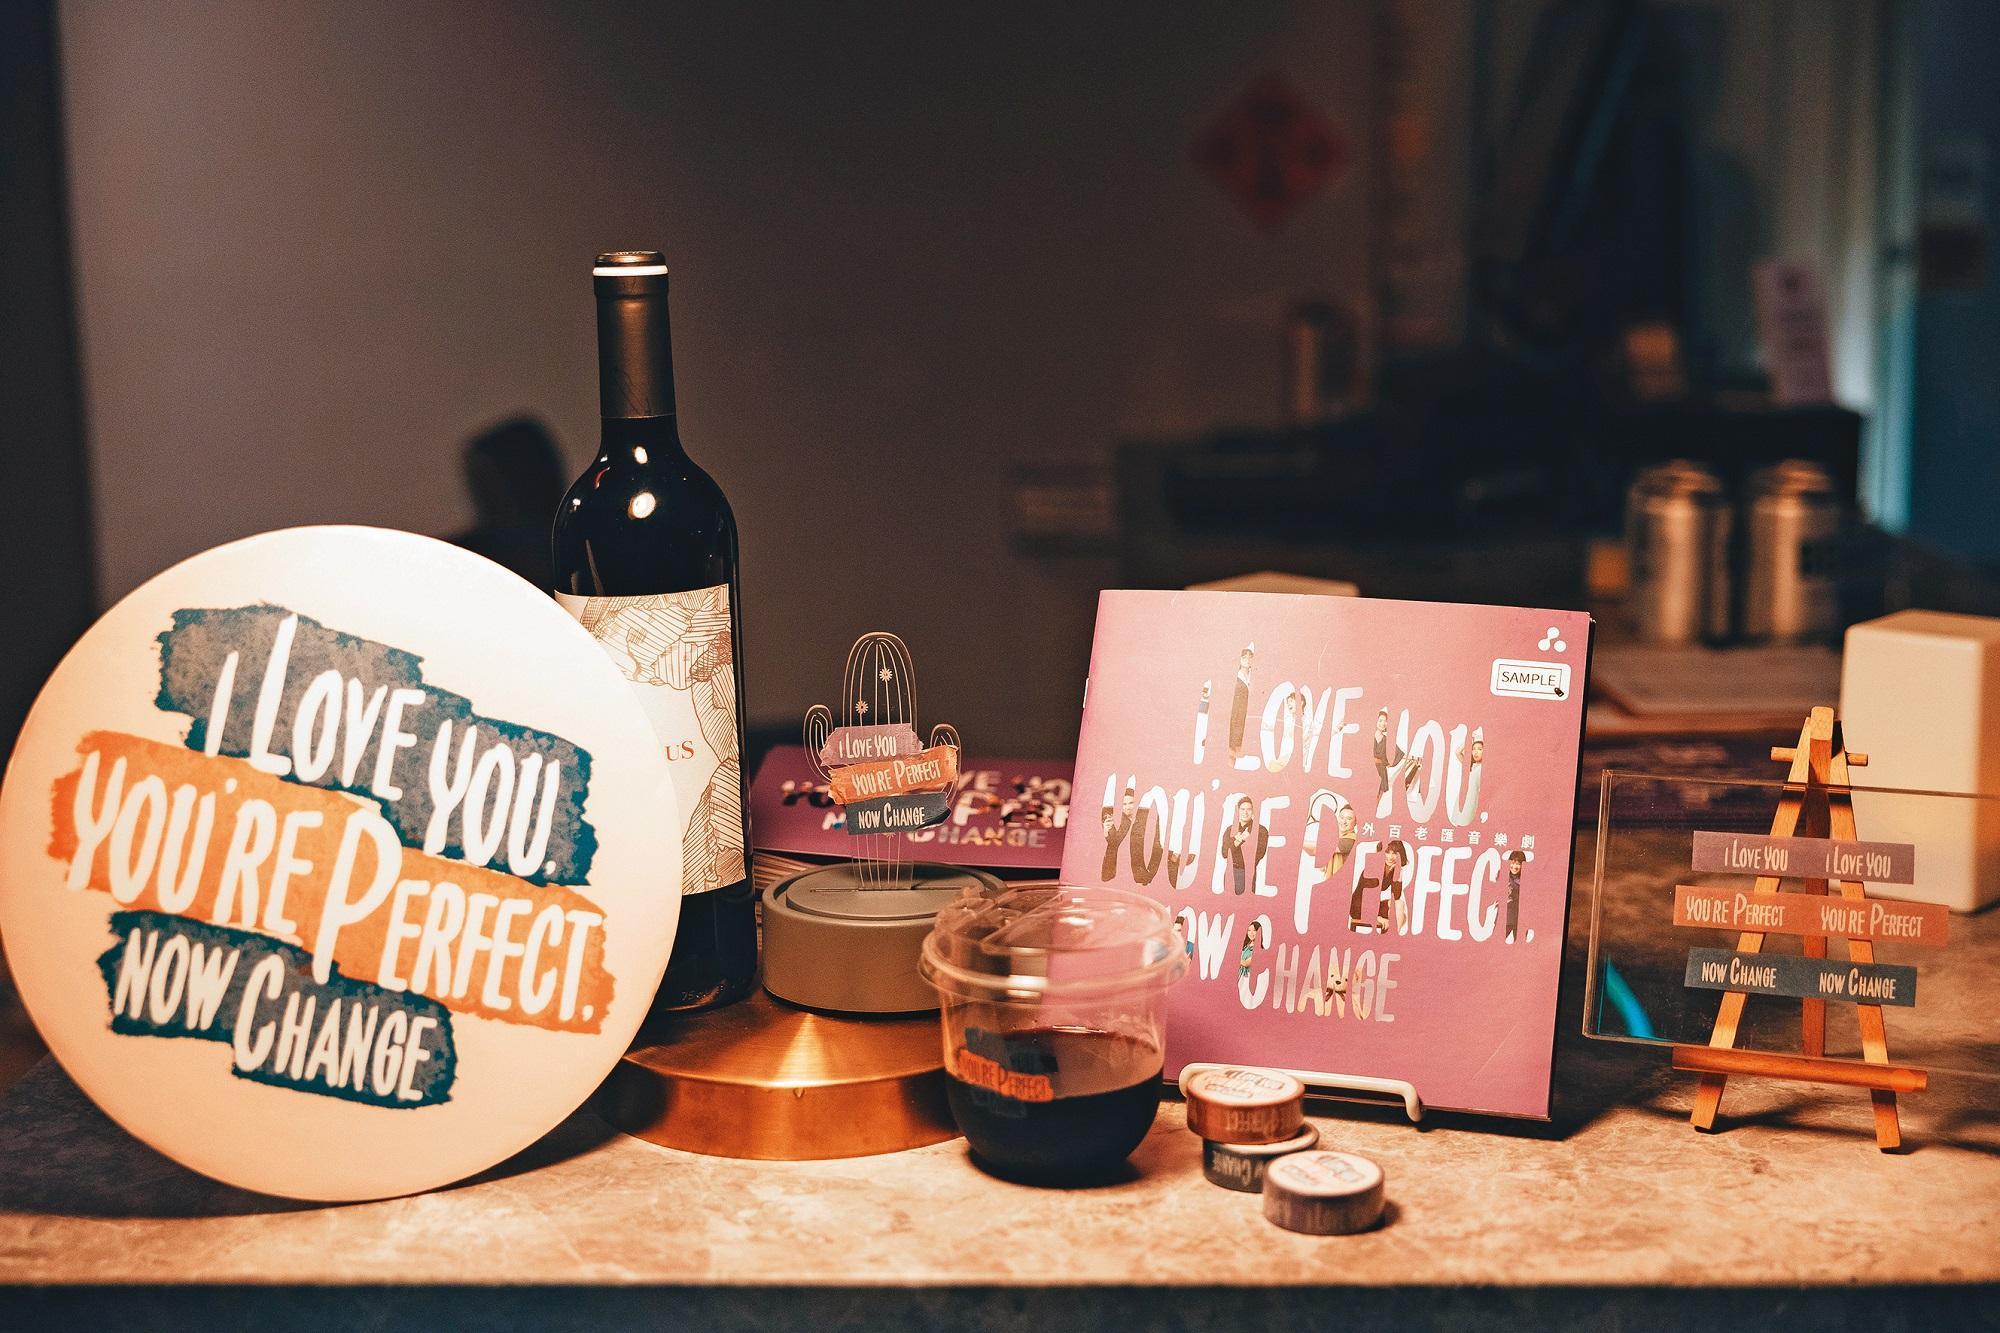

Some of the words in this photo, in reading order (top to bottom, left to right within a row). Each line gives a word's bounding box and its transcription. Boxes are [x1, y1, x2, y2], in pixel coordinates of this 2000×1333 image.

[1501, 671, 1556, 687] SAMPLE
[205, 651, 238, 757] I
[247, 612, 426, 800] LOVE
[1193, 679, 1212, 765] I
[1227, 641, 1364, 779] LOVE
[839, 740, 844, 758] I
[845, 732, 872, 759] LOVE
[874, 734, 897, 758] YOU
[851, 768, 893, 796] YOU'RE
[893, 760, 942, 788] PERFECT
[858, 810, 880, 829] NOW
[883, 802, 925, 827] CHANGE
[66, 750, 325, 934] YOU'RE
[1100, 772, 1291, 897] YOU'RE
[1725, 847, 1729, 867] I
[1732, 839, 1762, 869] LOVE
[1764, 846, 1788, 871] YOU
[1825, 854, 1830, 872] I
[1833, 845, 1863, 876] LOVE
[1866, 852, 1891, 878] YOU
[1686, 895, 1729, 923] YOU'RE
[1733, 893, 1785, 927] PERFECT
[1821, 905, 1865, 936] YOU'RE
[1870, 903, 1923, 937] PERFECT
[1166, 906, 1235, 980] OW
[1237, 914, 1402, 1024] CHANGE
[1701, 961, 1727, 983] NOW
[1730, 957, 1777, 988] CHANGE
[1819, 972, 1845, 994] NOW
[1848, 967, 1896, 999] CHANGE
[112, 928, 239, 1027] NOW
[232, 954, 437, 1101] CHANGE
